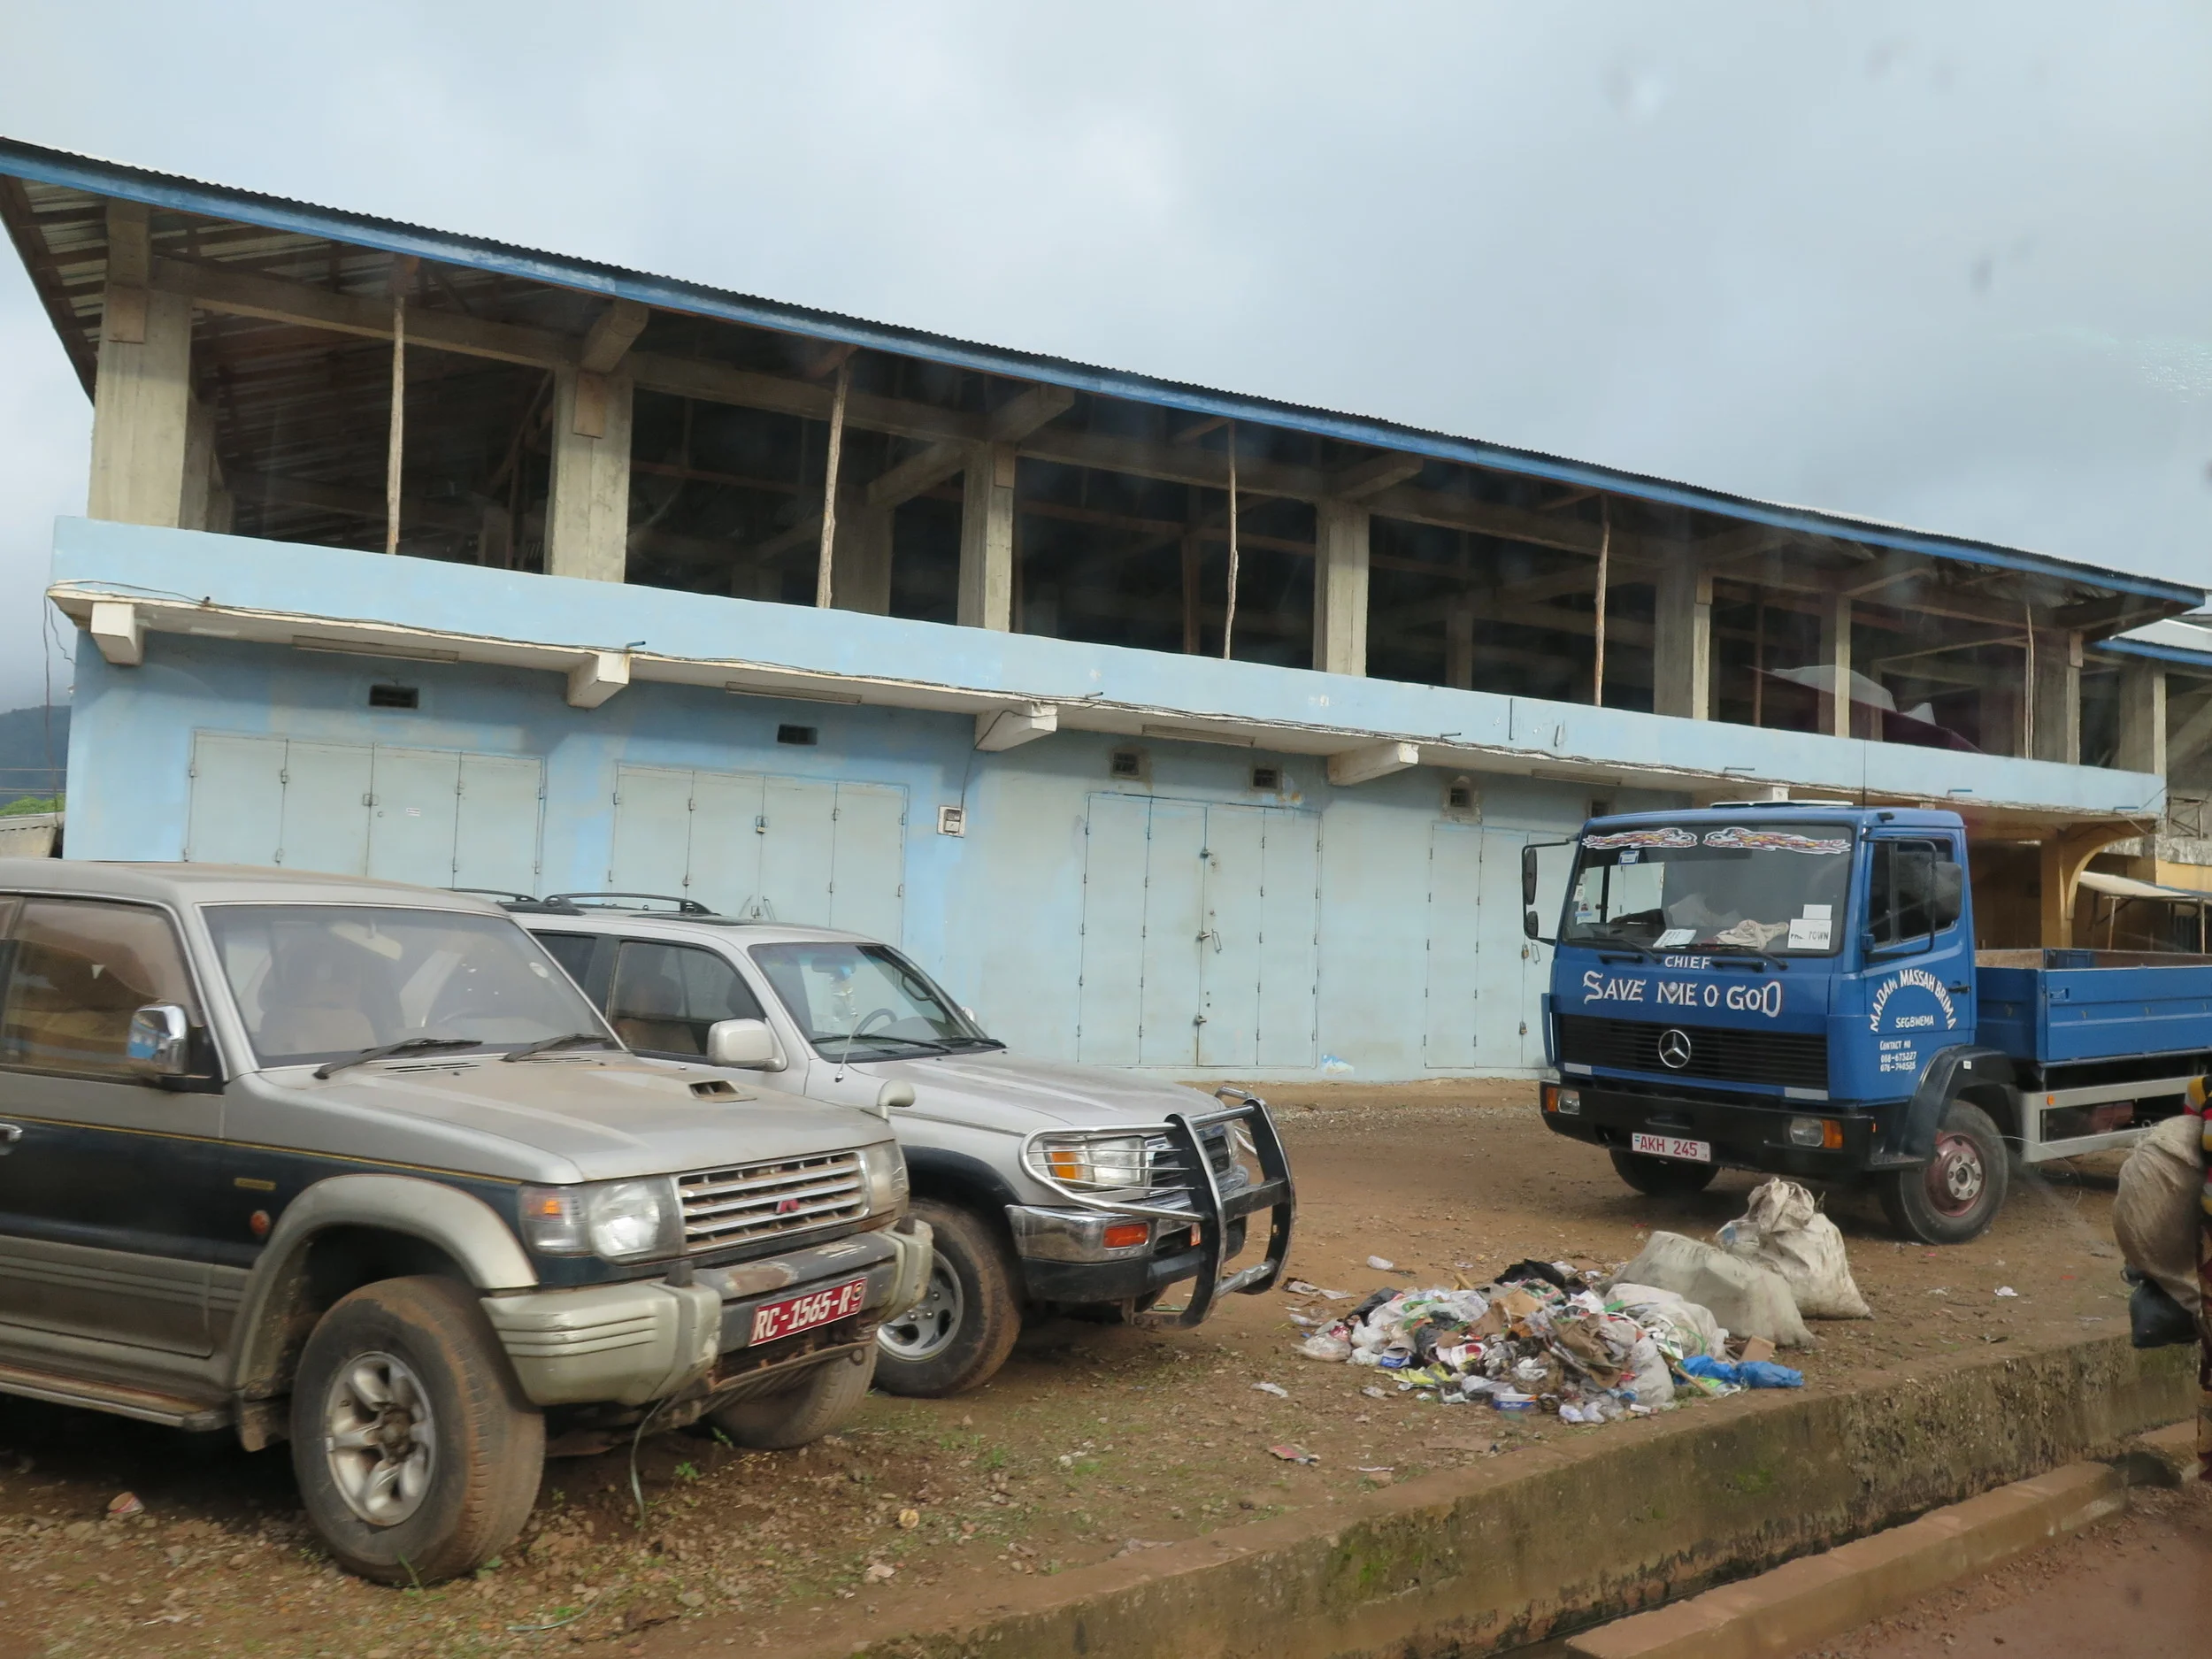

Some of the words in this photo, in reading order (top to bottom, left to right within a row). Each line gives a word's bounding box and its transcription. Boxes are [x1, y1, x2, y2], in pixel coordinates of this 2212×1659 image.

[1664, 956, 1711, 970] CHIEF
[1582, 970, 1647, 1005] SAVE
[1656, 981, 1698, 1007] ME
[1703, 984, 1720, 1008] O
[1726, 980, 1783, 1018] GOD
[1870, 977, 1898, 1033] MADAM
[1899, 969, 1936, 993] MASSAH
[1934, 979, 1957, 1030] BRIMA
[1895, 1015, 1934, 1028] SEGBWEMA
[1640, 1135, 1665, 1153] AKH
[1673, 1140, 1698, 1156] 245
[752, 1285, 852, 1341] RC-1565-R
